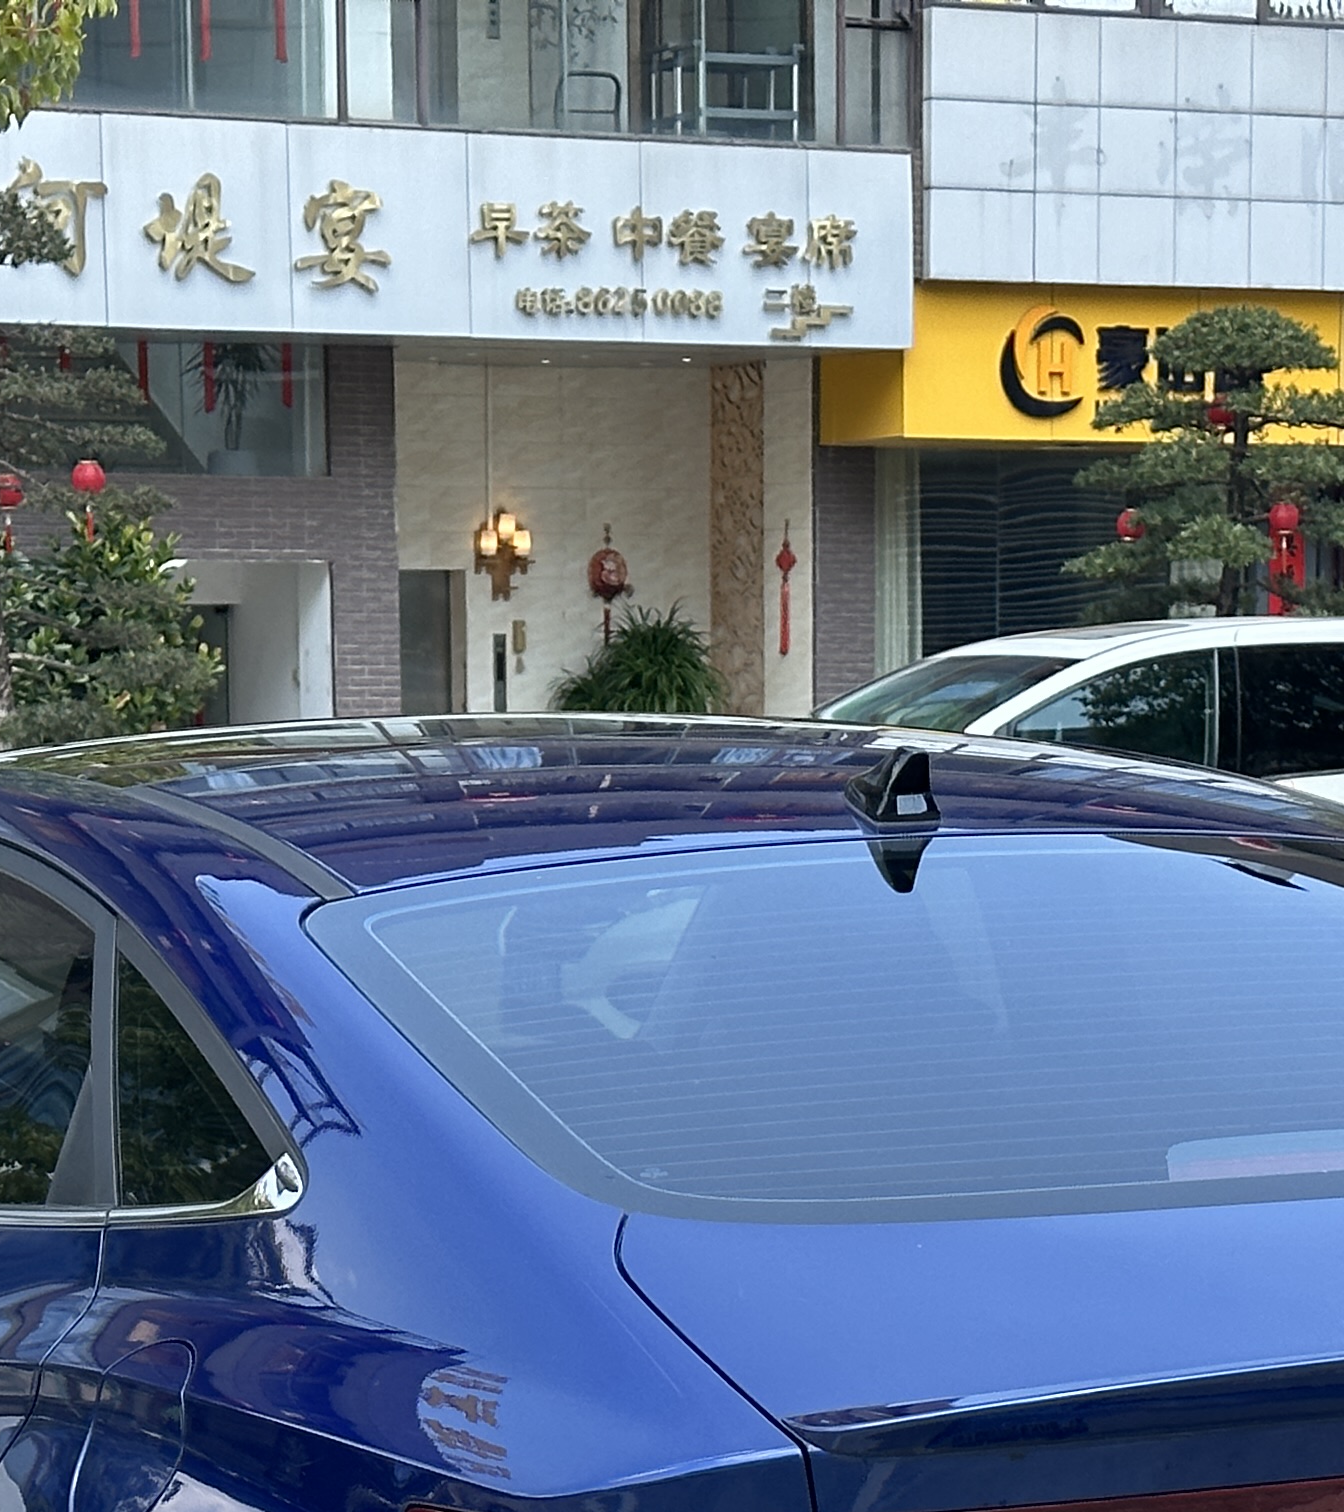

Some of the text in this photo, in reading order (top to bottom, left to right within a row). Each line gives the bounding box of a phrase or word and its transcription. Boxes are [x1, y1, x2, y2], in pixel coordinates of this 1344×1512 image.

[470, 201, 859, 271] 早茶 中餐 宴席
